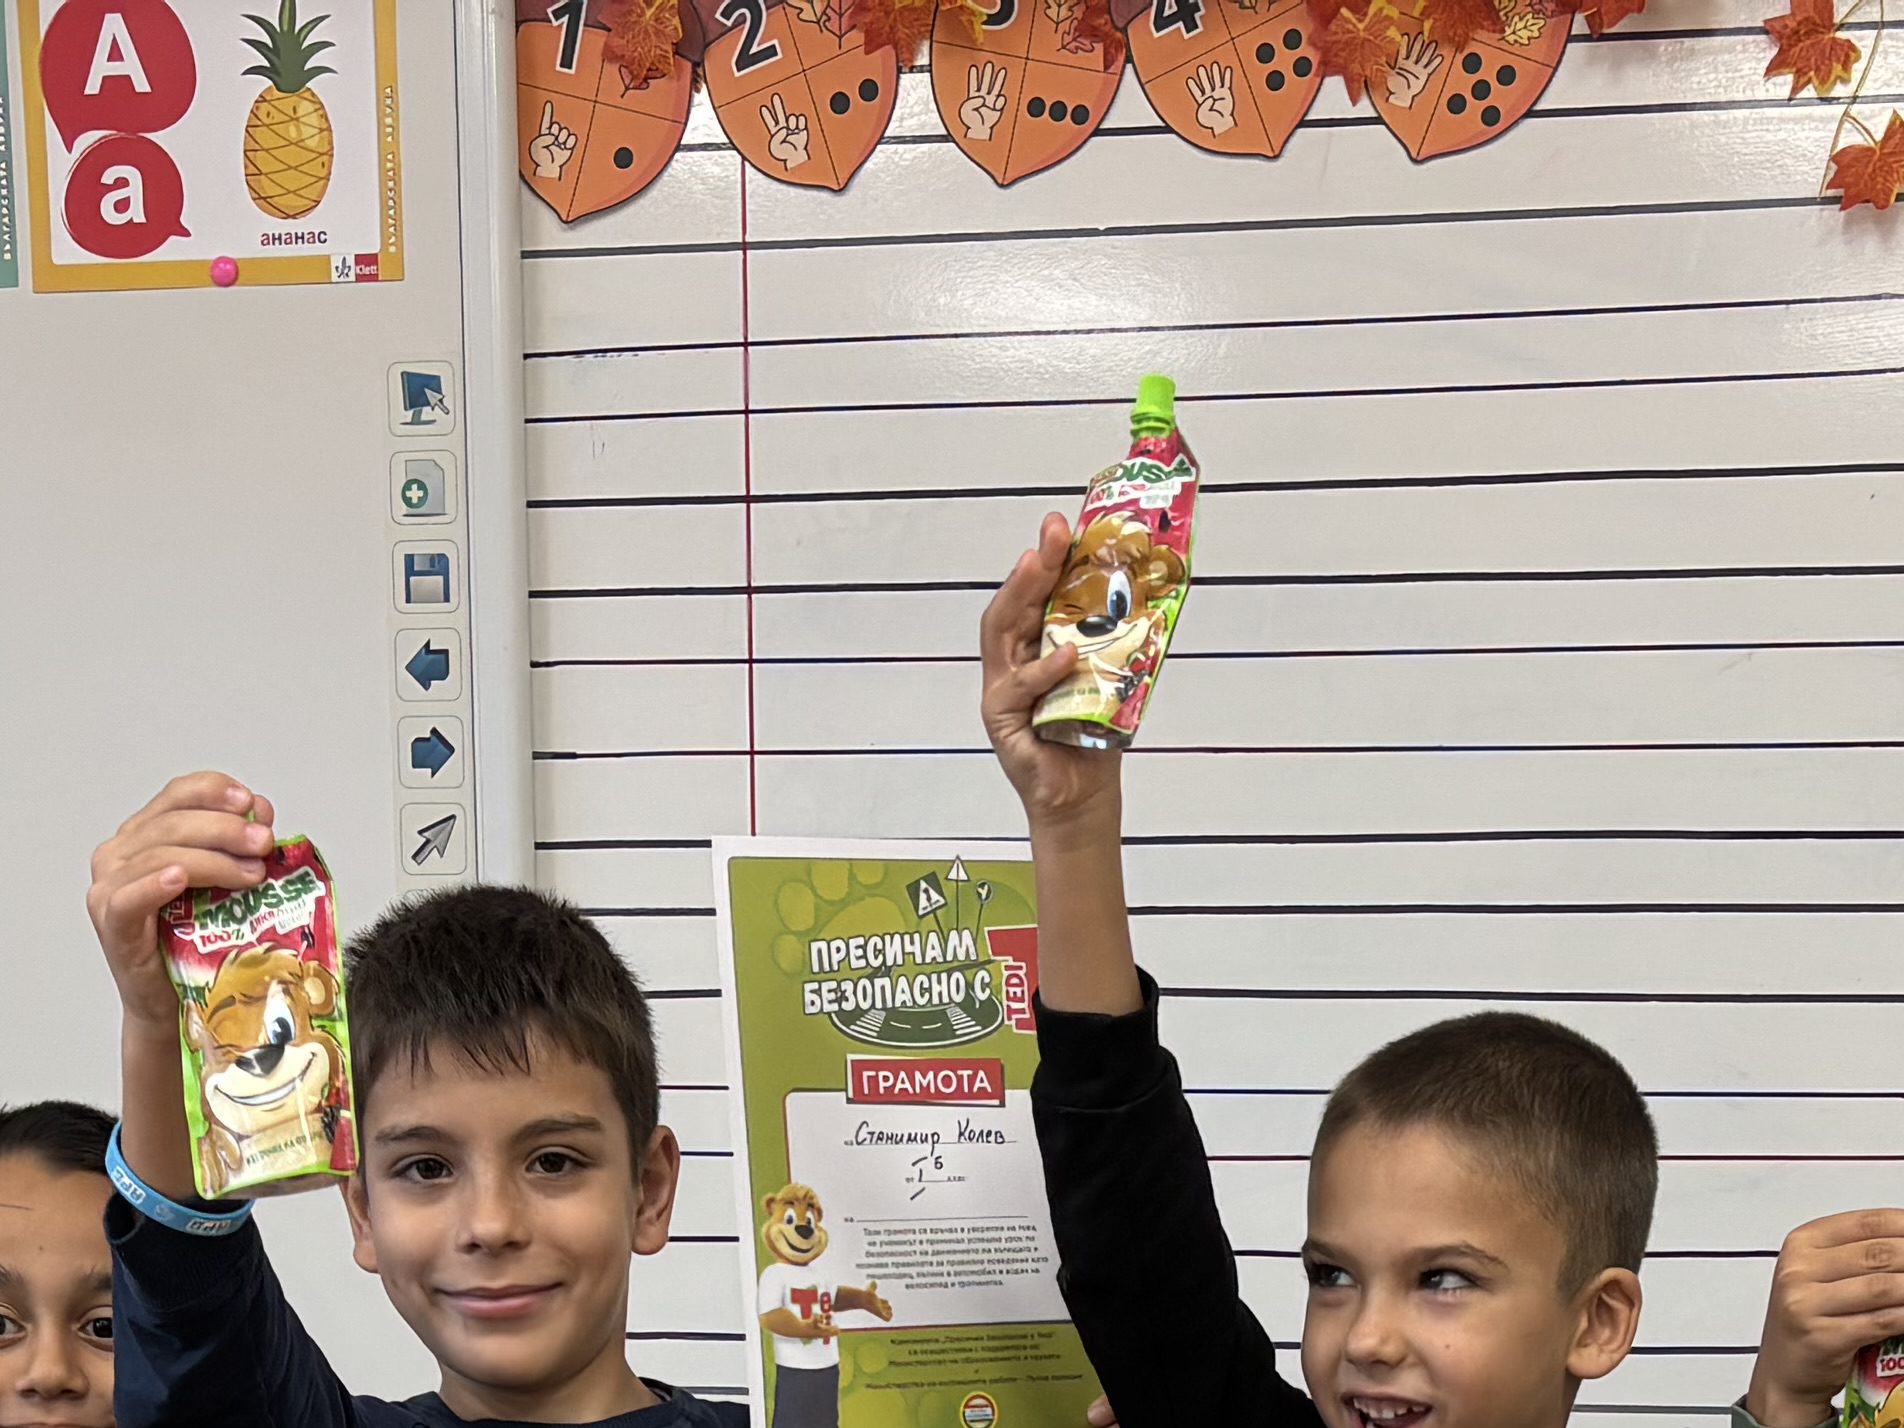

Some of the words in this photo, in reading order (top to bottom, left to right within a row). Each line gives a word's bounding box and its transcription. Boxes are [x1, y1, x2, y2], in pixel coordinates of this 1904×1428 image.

[84, 14, 152, 95] А
[550, 0, 586, 69] 1
[731, 0, 780, 72] 2
[100, 165, 147, 224] а
[260, 230, 327, 247] ананас
[356, 265, 379, 276] Klett
[855, 1121, 940, 1157] Станимир
[958, 1119, 1005, 1145] Колев
